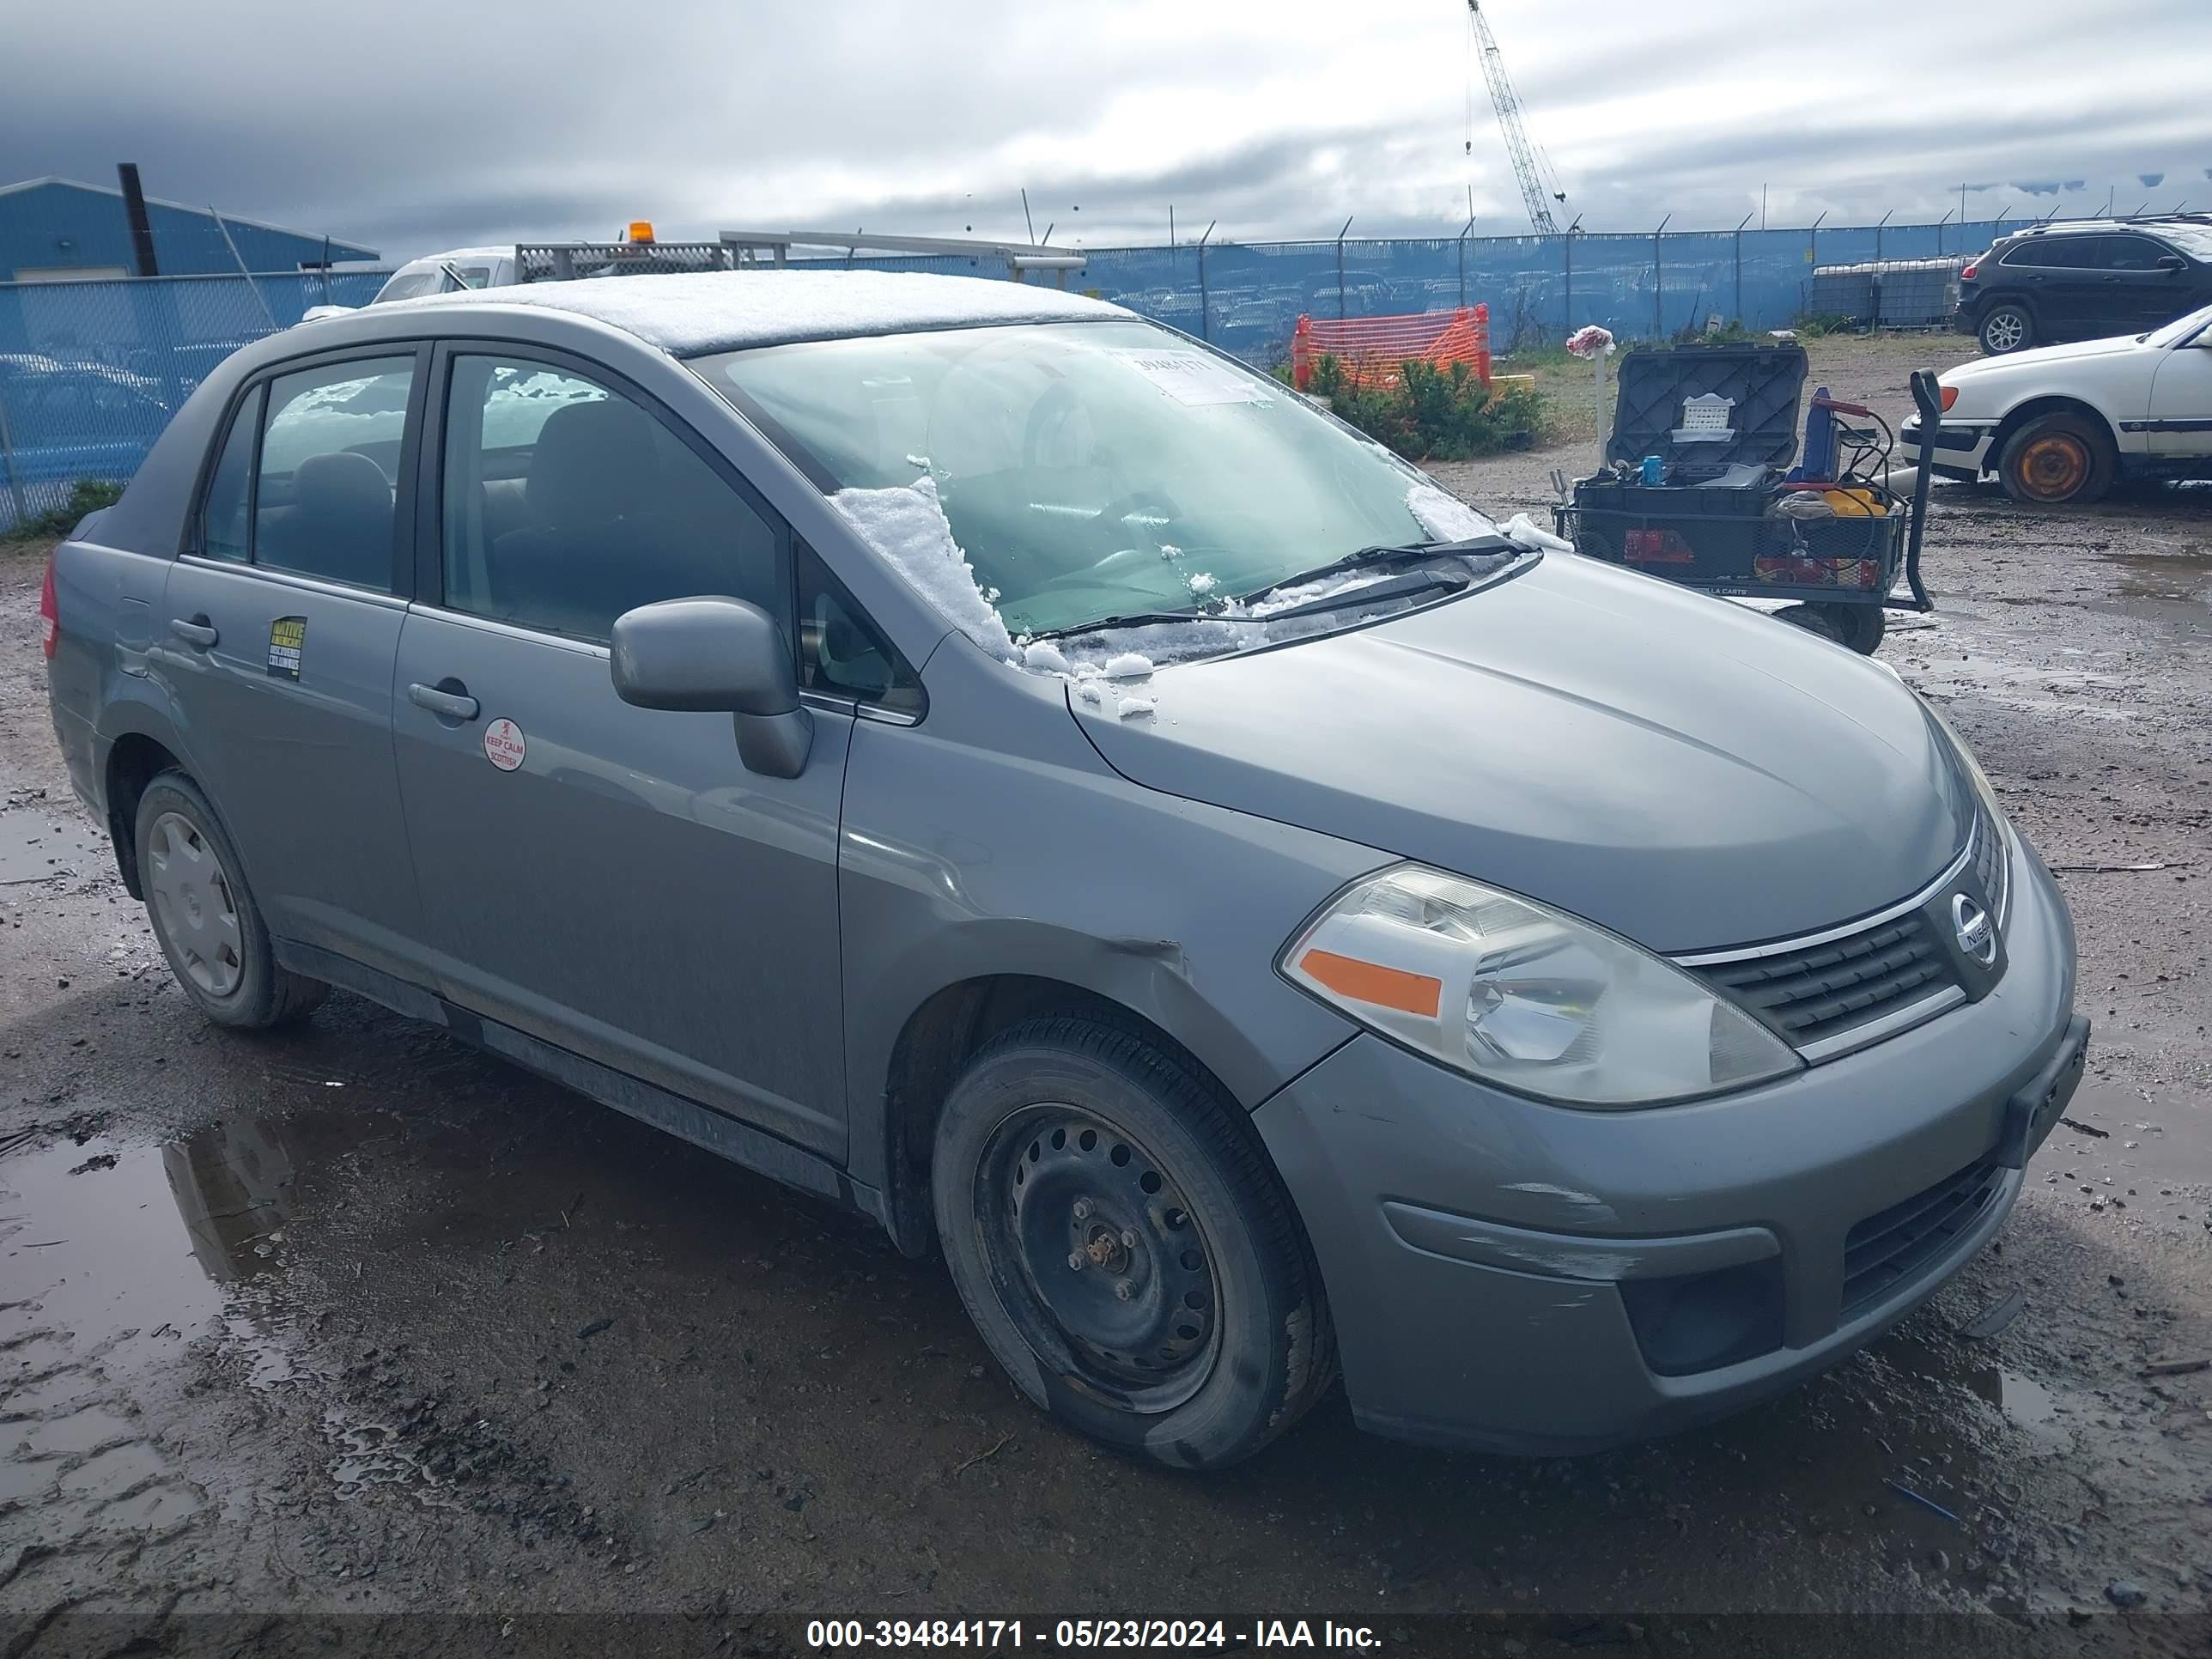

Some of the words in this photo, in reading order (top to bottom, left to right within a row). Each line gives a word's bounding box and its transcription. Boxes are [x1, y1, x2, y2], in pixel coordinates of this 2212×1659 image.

[1133, 360, 1212, 372] 39484171
[273, 622, 305, 640] NATIVE
[486, 735, 503, 747] KEEP
[504, 741, 524, 755] CALM
[490, 751, 517, 768] SCOTTISH
